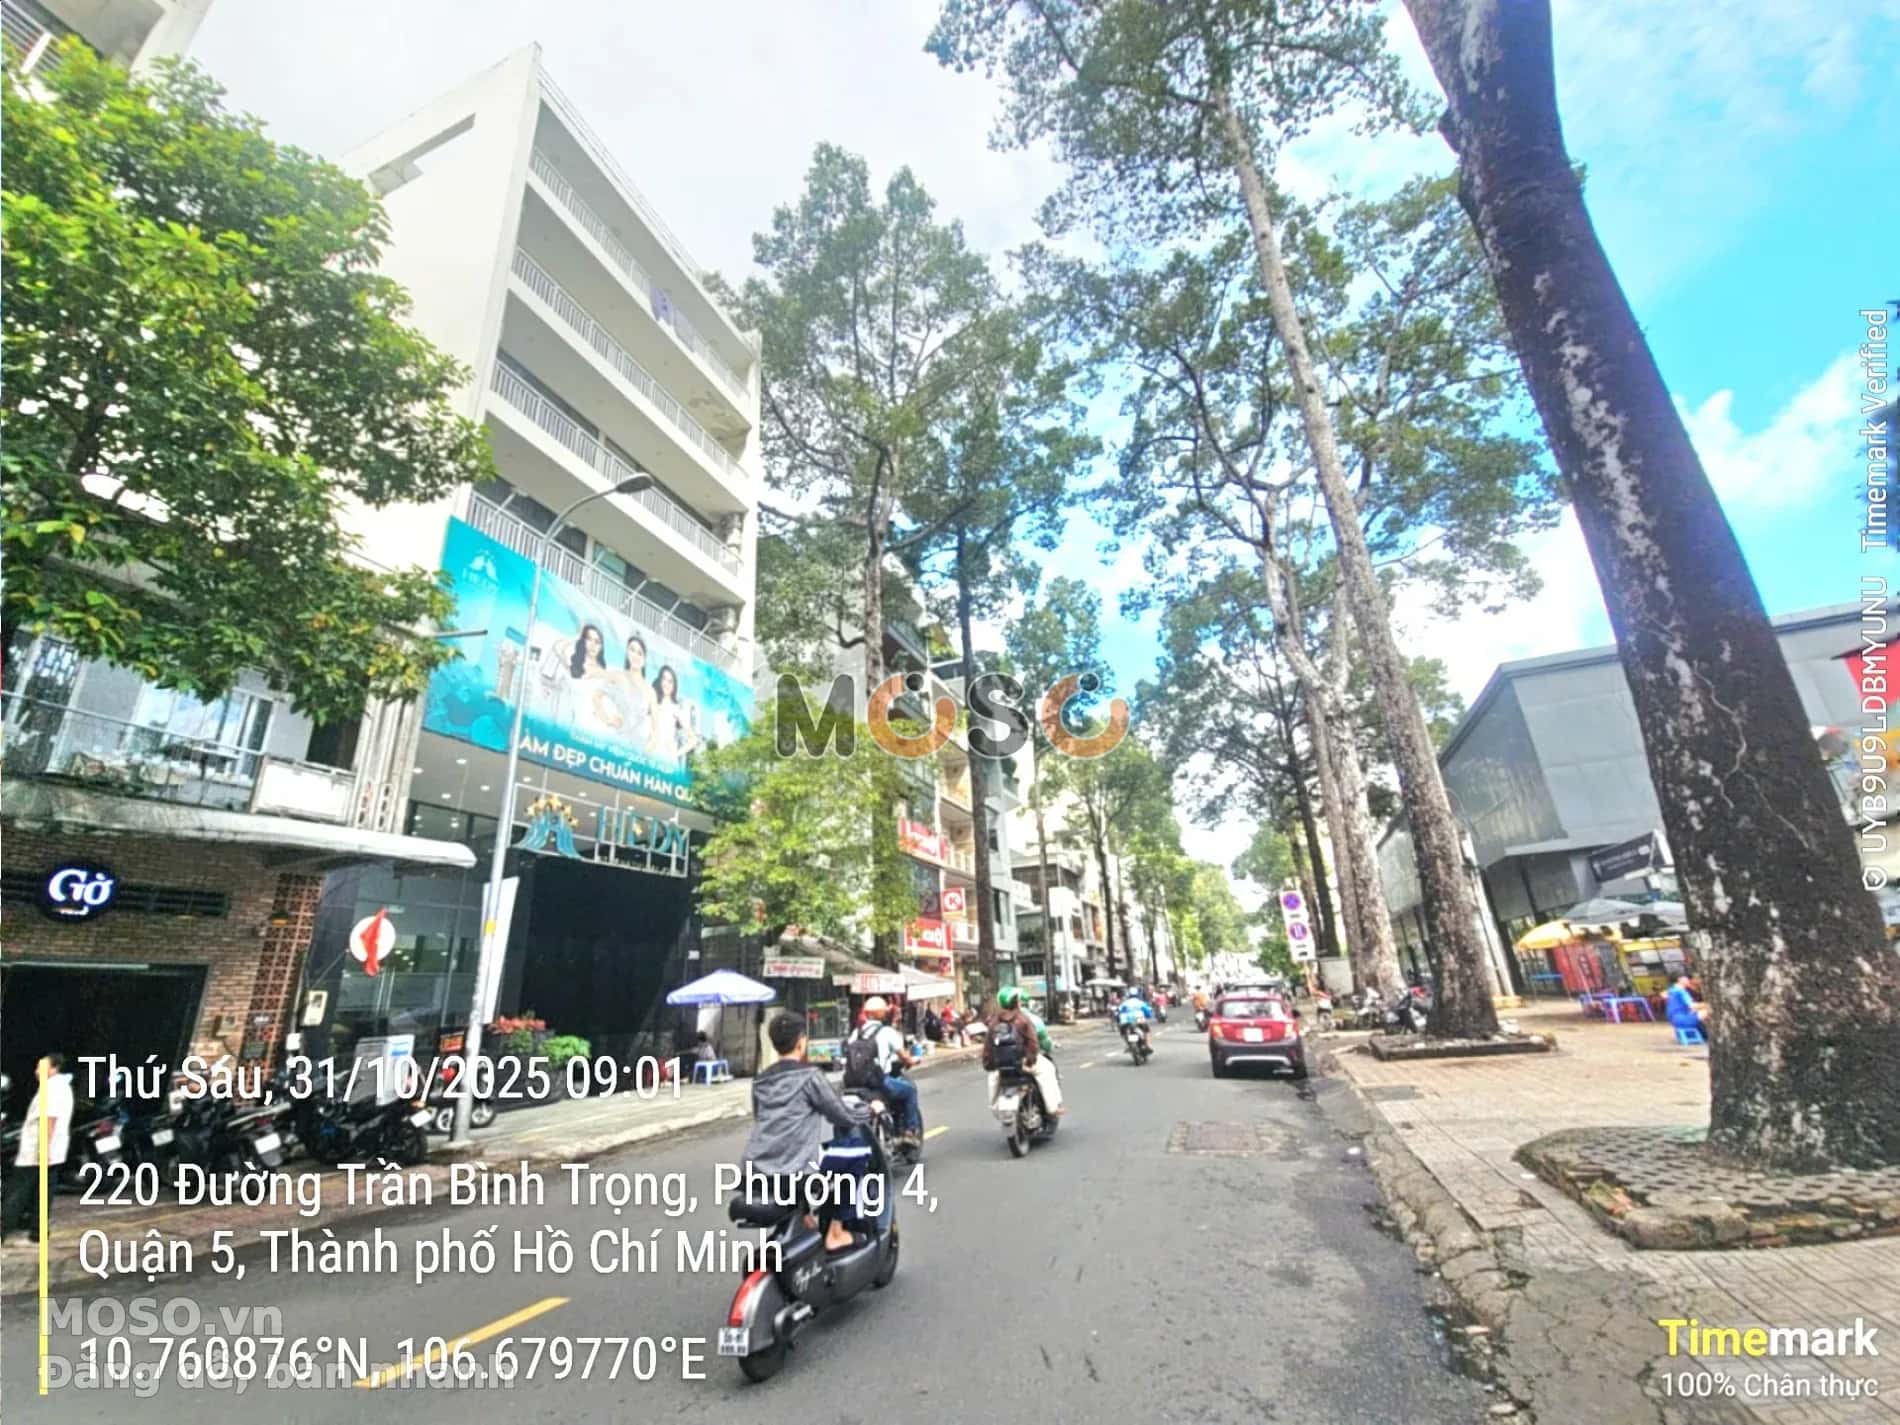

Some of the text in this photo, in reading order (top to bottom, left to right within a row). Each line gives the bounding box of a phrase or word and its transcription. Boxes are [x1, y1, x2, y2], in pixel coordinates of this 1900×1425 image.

[519, 728, 548, 757] ÀM
[553, 743, 586, 769] ĐẸP
[48, 868, 114, 905] Gờ
